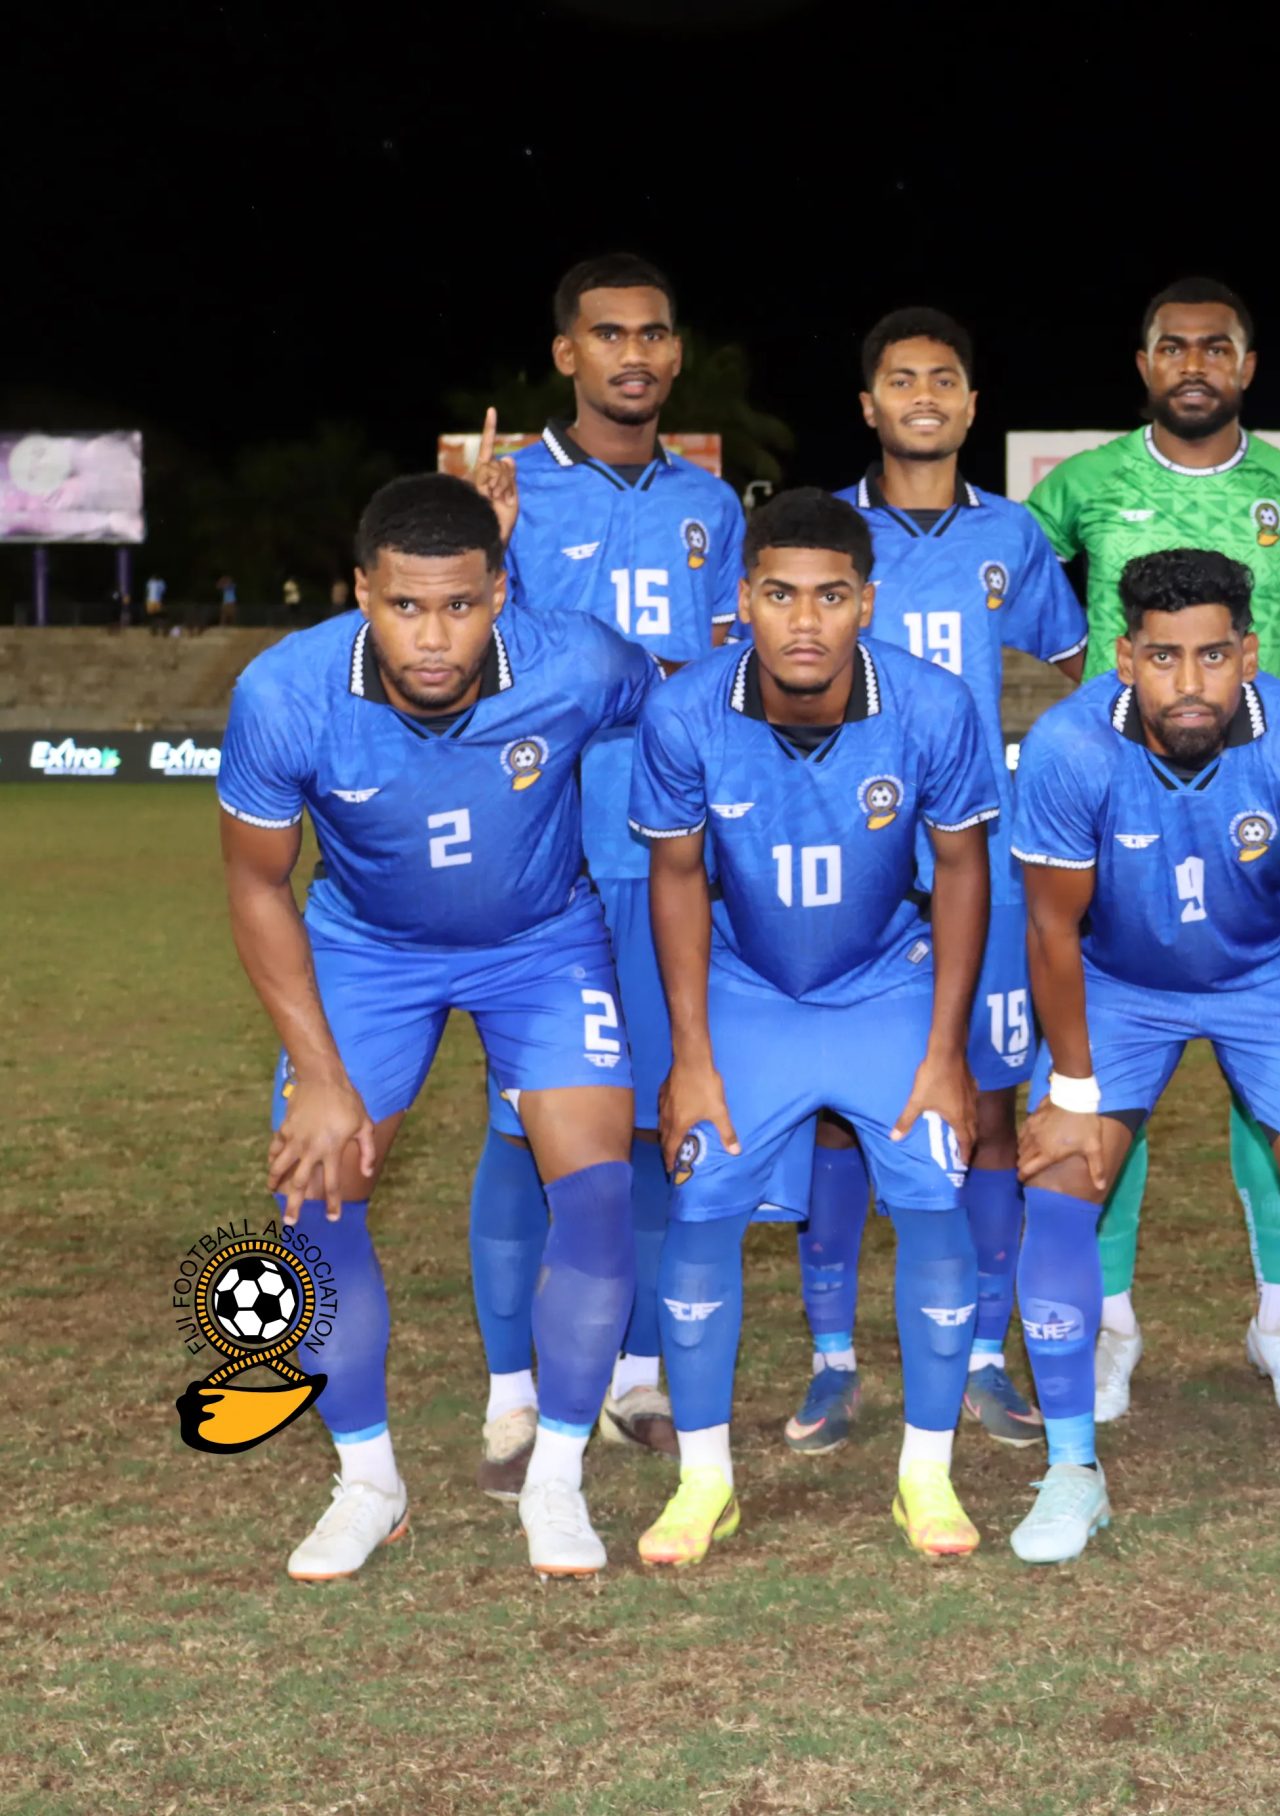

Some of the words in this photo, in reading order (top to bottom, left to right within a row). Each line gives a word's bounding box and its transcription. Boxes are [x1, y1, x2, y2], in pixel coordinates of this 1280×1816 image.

[610, 568, 671, 635] 15
[903, 610, 962, 676] 19
[30, 738, 101, 768] Extra
[150, 738, 221, 769] Extra
[427, 808, 472, 868] 2
[772, 844, 842, 908] 10
[1175, 856, 1207, 923] 9
[581, 988, 621, 1053] 2
